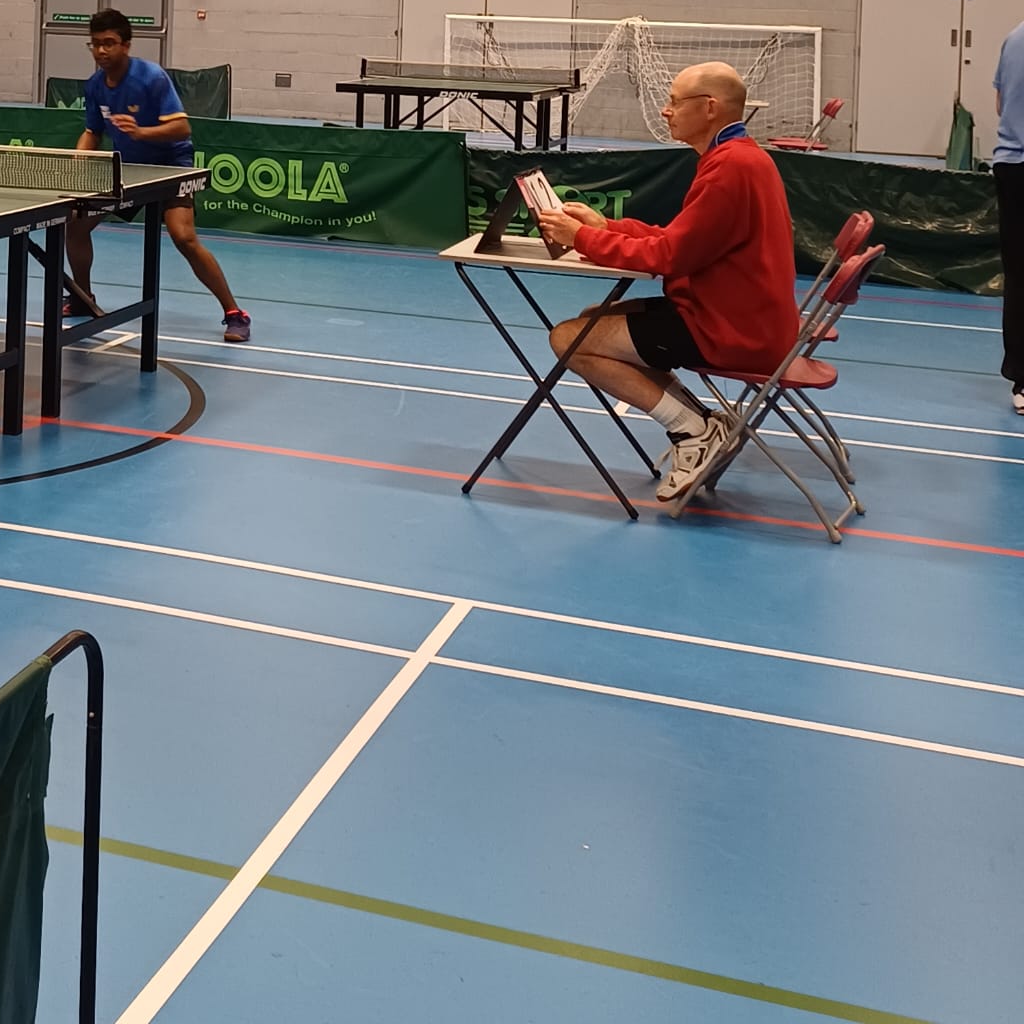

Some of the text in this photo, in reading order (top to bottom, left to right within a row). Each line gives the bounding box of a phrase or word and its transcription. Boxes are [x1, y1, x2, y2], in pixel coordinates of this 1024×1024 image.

[439, 90, 479, 99] DONIC
[203, 199, 378, 228] for the Champion in you!
